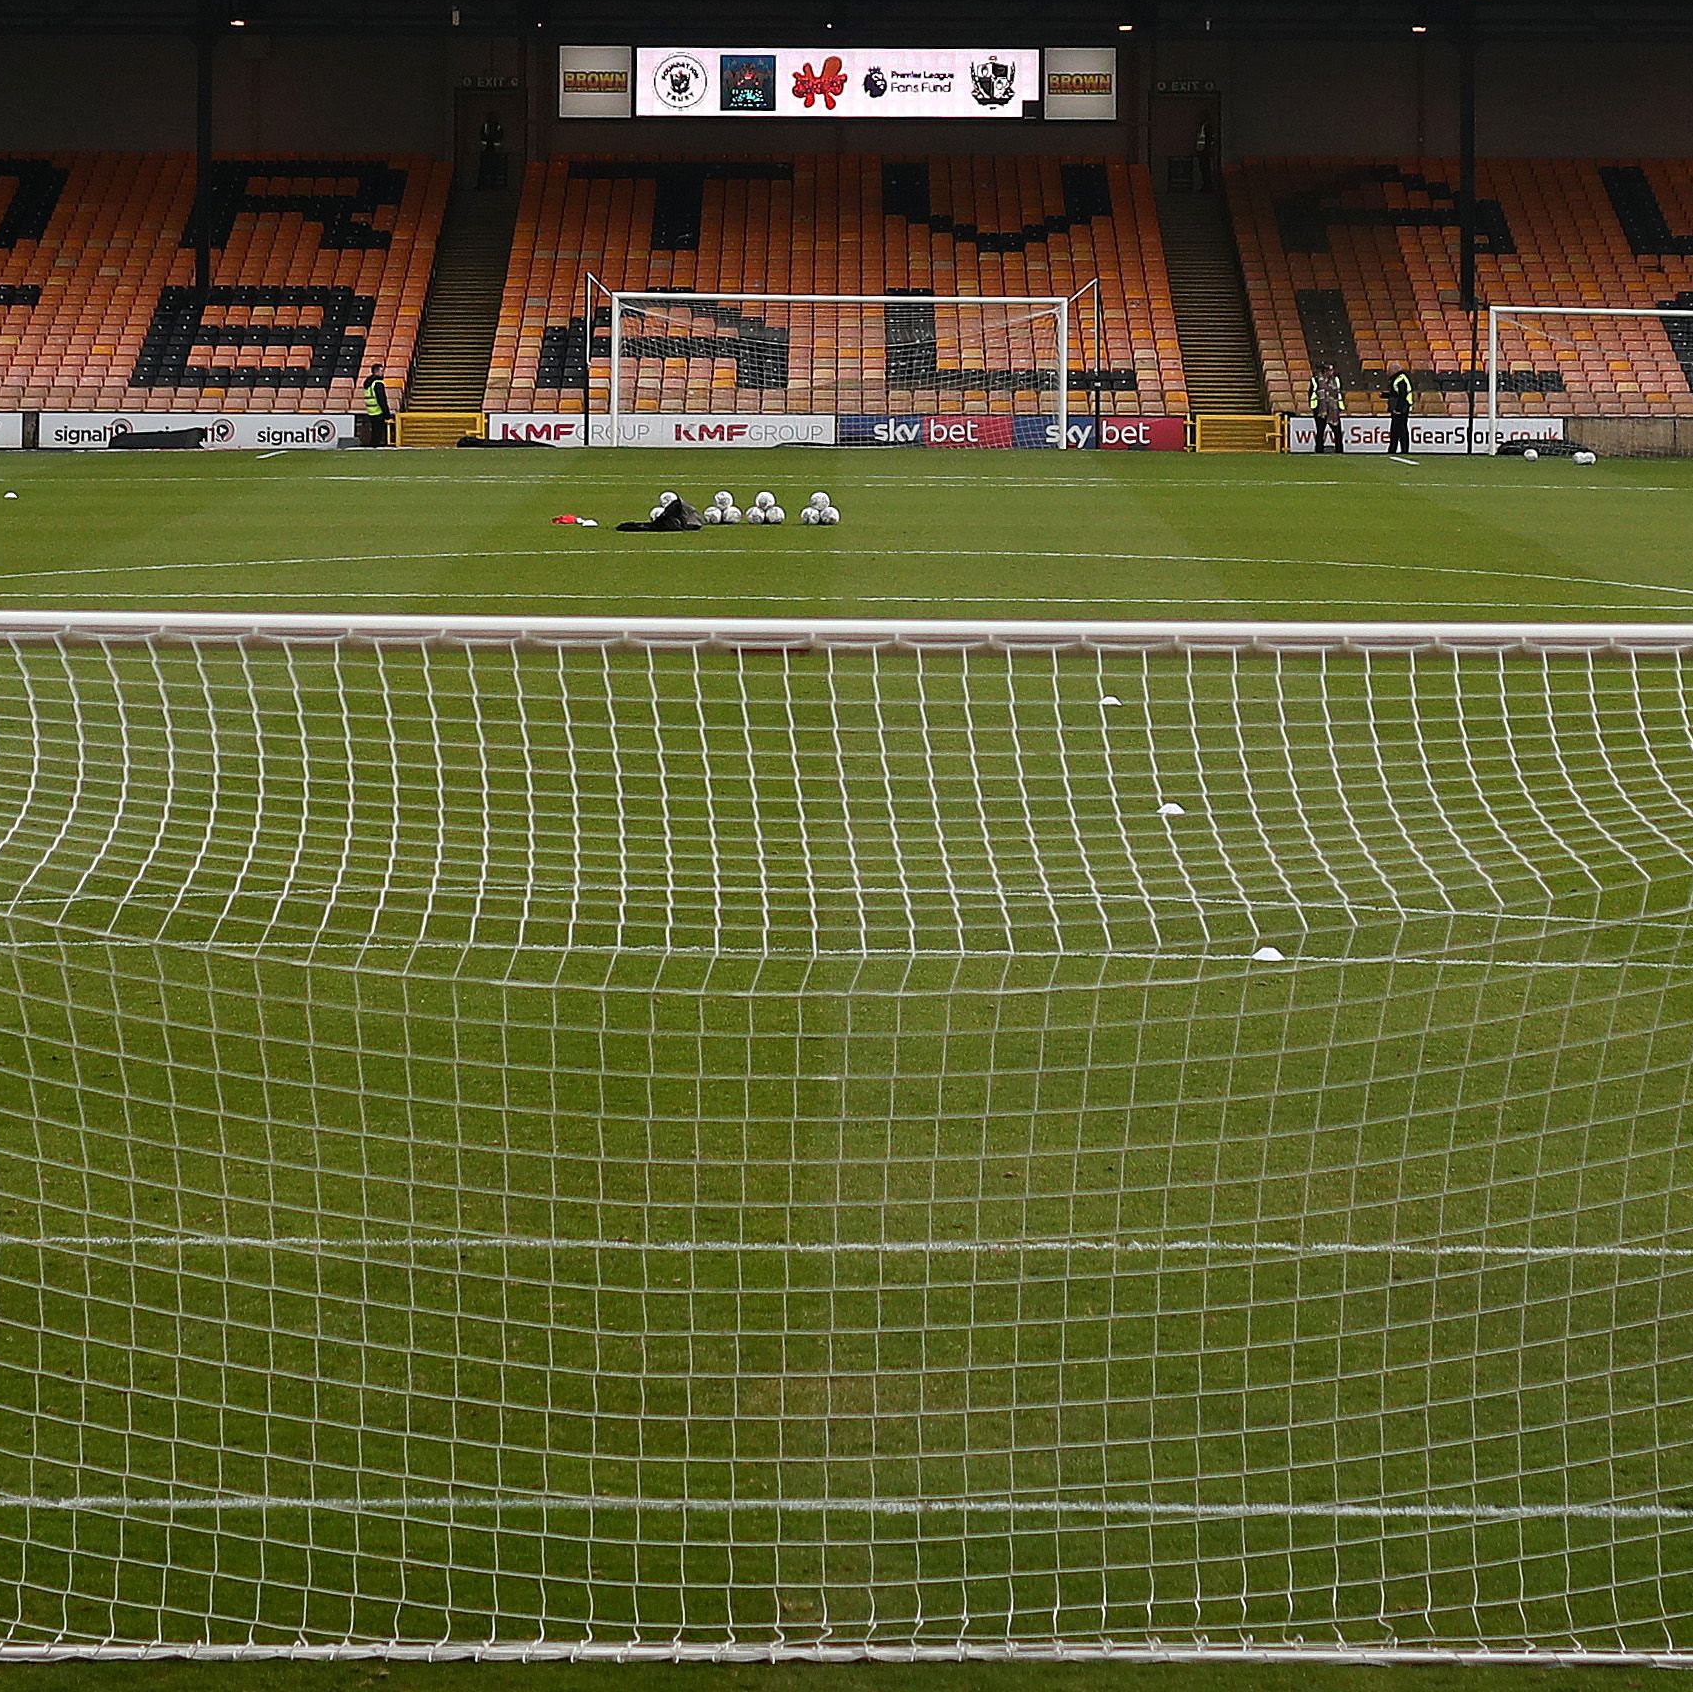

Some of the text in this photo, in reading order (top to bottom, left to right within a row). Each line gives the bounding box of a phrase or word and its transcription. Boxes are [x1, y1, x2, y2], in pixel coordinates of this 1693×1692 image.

[477, 76, 504, 87] EXIT
[564, 72, 627, 87] BROWN
[923, 70, 954, 81] League
[1049, 74, 1111, 89] BROWN
[891, 81, 951, 93] Fans Fund
[1171, 81, 1199, 91] EXIT
[666, 91, 695, 102] TRUST
[874, 418, 979, 445] sky bet
[1102, 420, 1151, 444] bet
